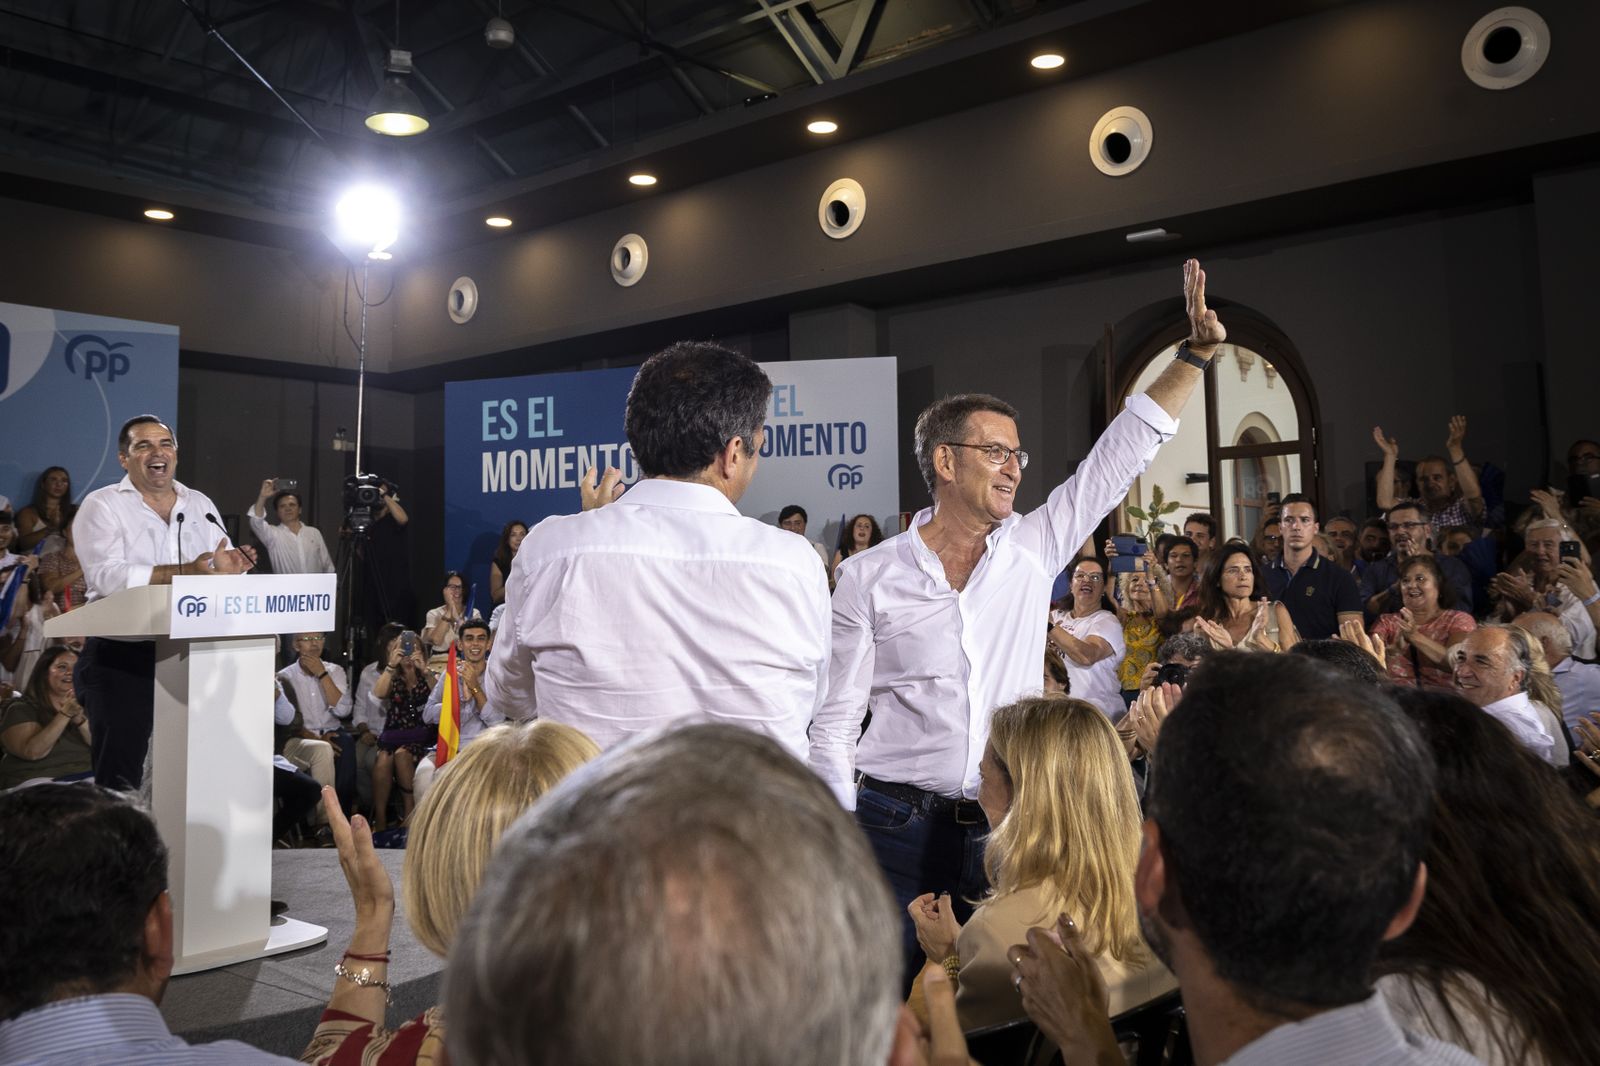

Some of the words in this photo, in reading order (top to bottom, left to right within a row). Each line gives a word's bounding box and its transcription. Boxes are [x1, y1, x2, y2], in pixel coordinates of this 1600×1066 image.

[482, 399, 518, 441] ES
[528, 396, 564, 438] EL
[773, 384, 804, 417] EL
[759, 421, 867, 458] OMENTO
[481, 442, 638, 493] MOMENTO
[224, 596, 242, 615] ES
[246, 595, 261, 613] EL
[265, 593, 330, 613] MOMENTO
